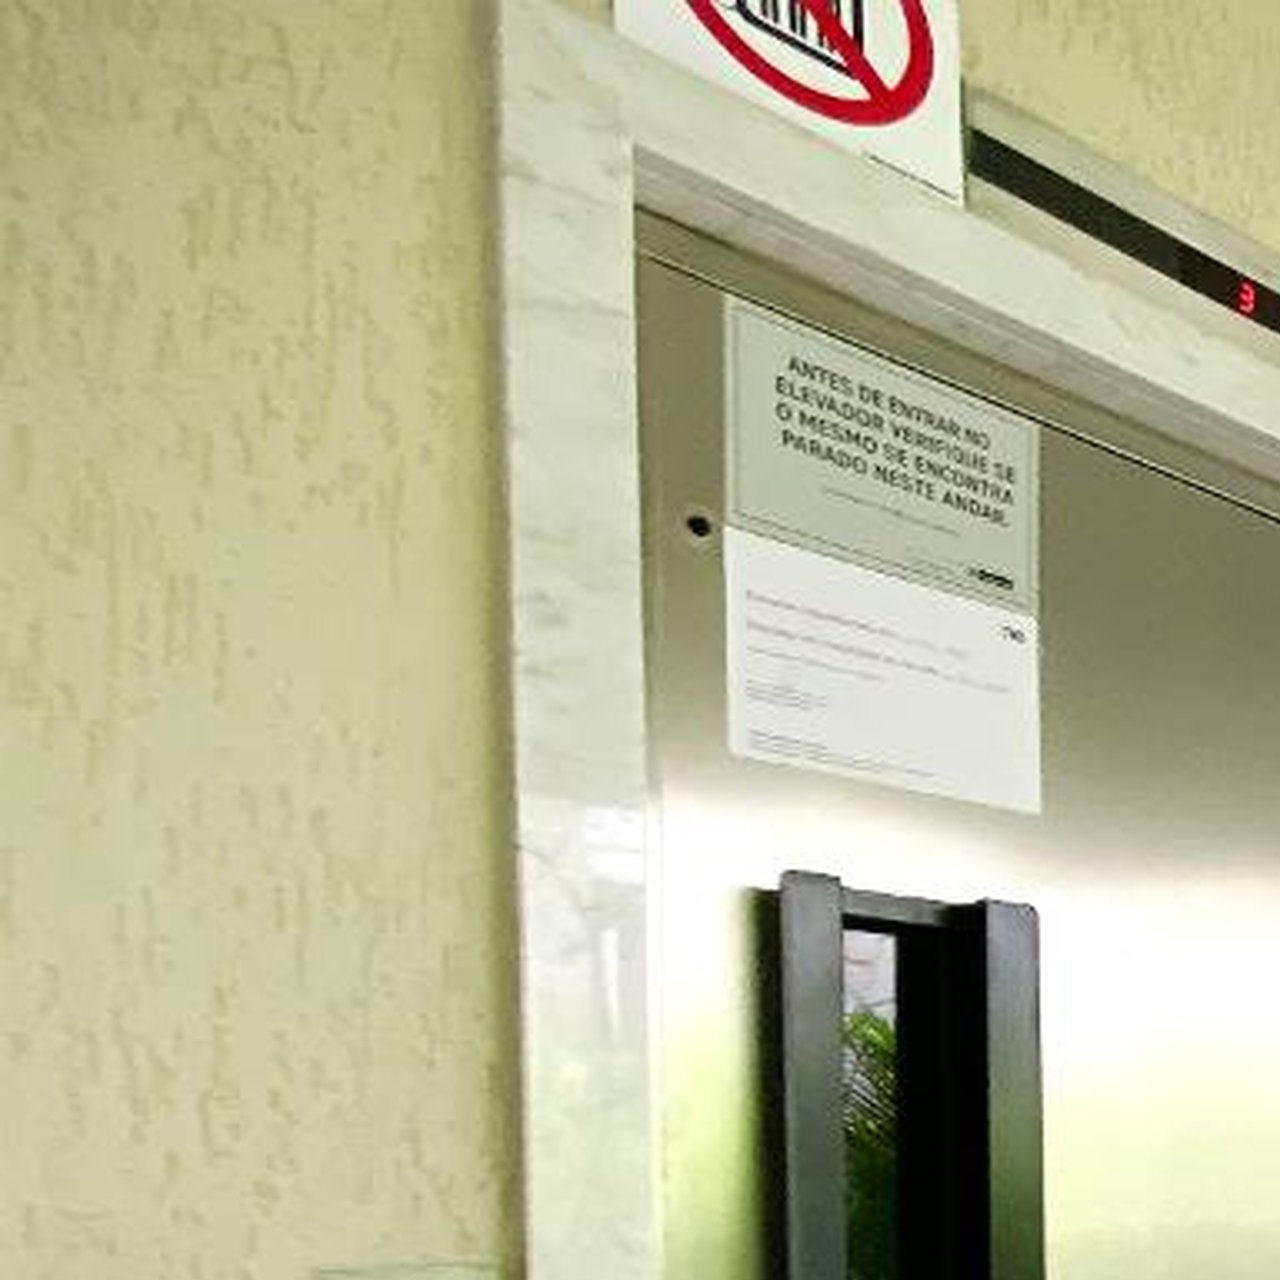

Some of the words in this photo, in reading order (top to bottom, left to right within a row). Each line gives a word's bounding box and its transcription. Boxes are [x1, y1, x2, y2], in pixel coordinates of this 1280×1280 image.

[1239, 282, 1254, 313] 3
[776, 376, 885, 432] ELEVADOR
[893, 424, 989, 474] VERIFIQUE
[994, 463, 1014, 485] SE
[789, 357, 853, 396] ANTES
[858, 385, 882, 405] DE
[888, 396, 960, 440] ENTRAR
[964, 428, 991, 451] NO
[776, 402, 792, 422] O
[799, 411, 878, 455] MESMO
[883, 443, 909, 469] SE
[914, 455, 1014, 506] ENCONTRA
[782, 429, 867, 475] PARADO
[874, 464, 934, 500] NESTE
